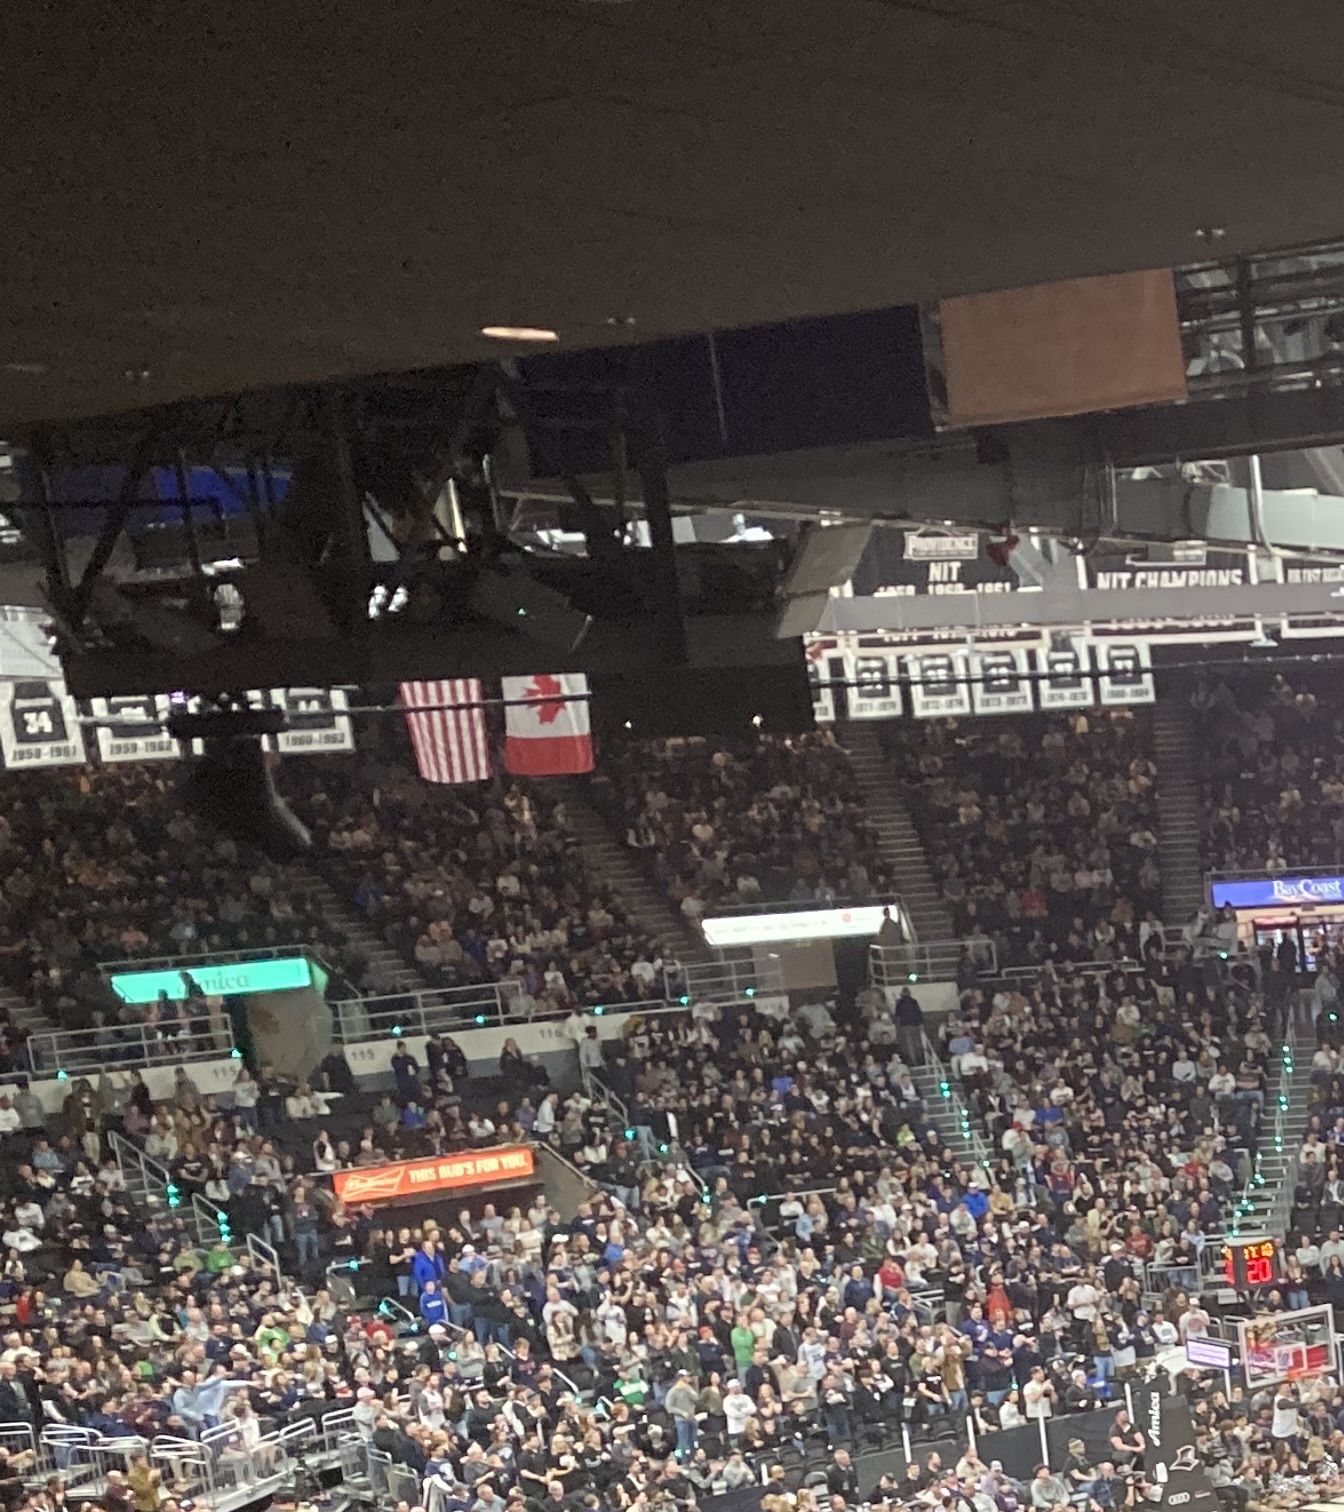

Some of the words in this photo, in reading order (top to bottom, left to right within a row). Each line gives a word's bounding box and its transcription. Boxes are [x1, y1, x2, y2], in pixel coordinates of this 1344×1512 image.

[928, 561, 961, 583] NIT
[1097, 571, 1131, 589] NIT
[1135, 569, 1242, 589] CHAMPIONS
[24, 711, 52, 734] 34
[1273, 879, 1342, 896] BayCoast
[409, 1169, 436, 1184] THIS
[439, 1164, 474, 1179] BUD'S
[476, 1159, 500, 1173] FOR
[1247, 1258, 1272, 1284] 20
[1148, 1392, 1161, 1447] Amica
